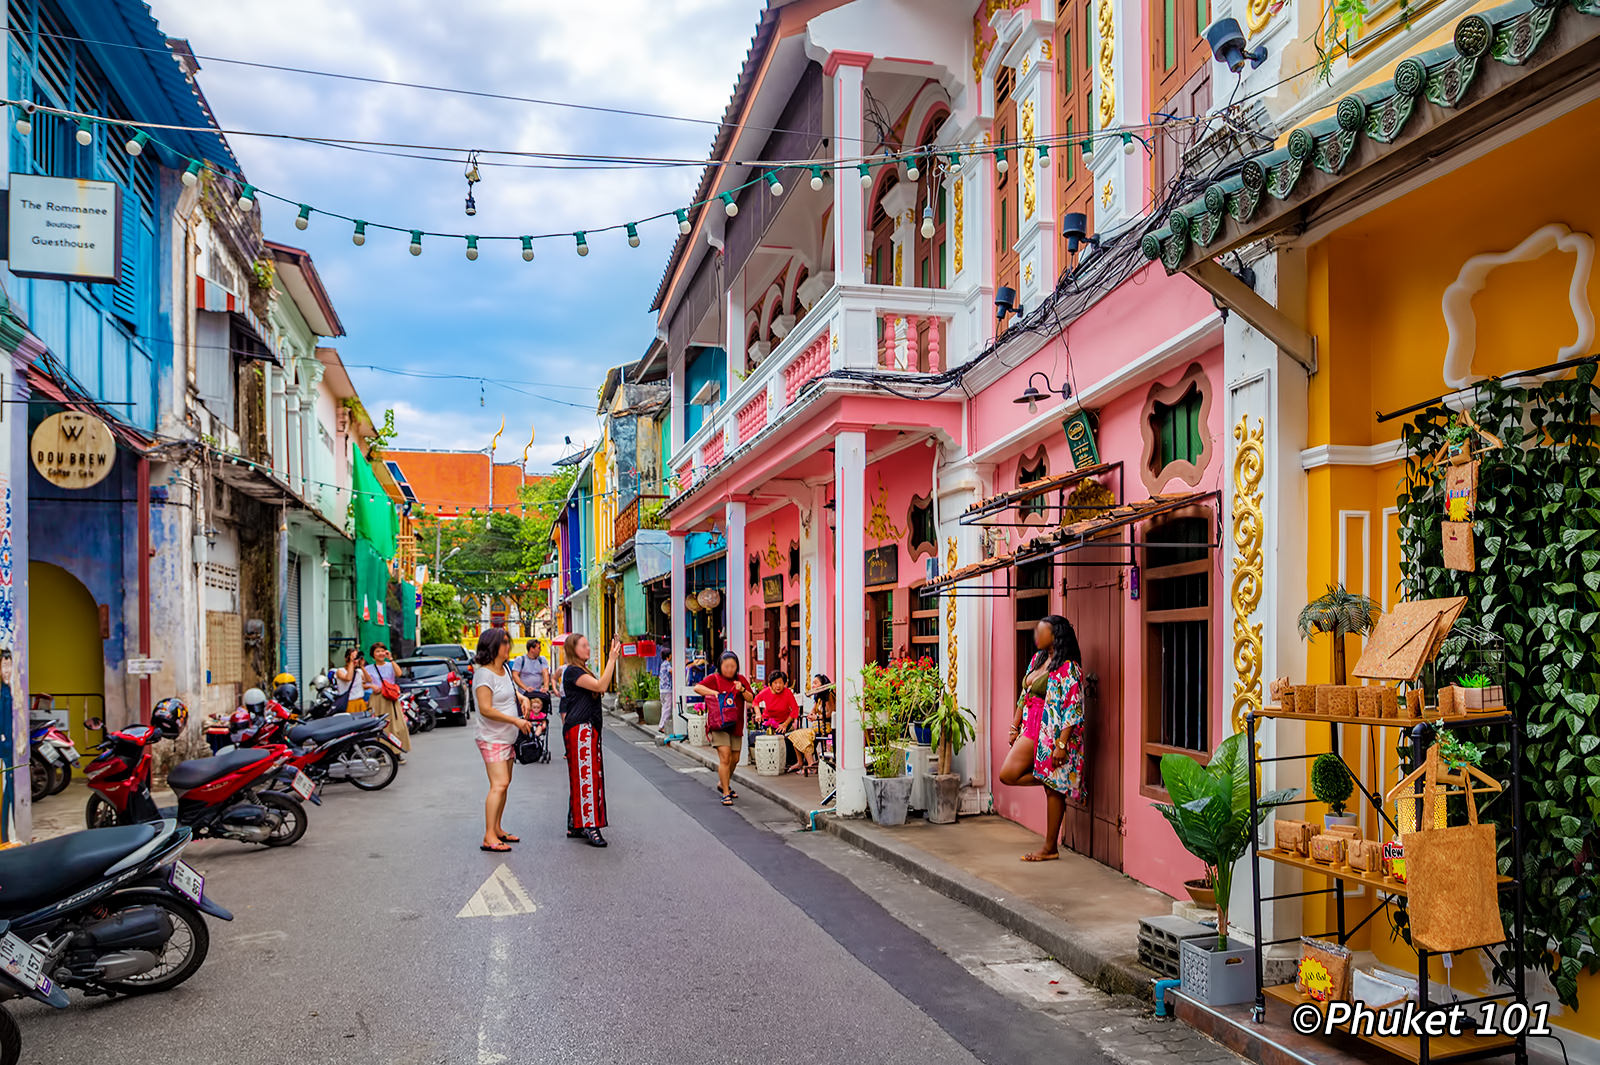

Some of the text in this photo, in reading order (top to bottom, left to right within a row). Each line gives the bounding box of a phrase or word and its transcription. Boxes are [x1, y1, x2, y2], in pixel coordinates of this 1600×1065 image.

[20, 199, 108, 216] The Rommanee
[45, 220, 81, 230] Boutique
[31, 235, 96, 250] Guesthouse
[61, 425, 84, 441] W
[1384, 843, 1404, 859] New
[24, 953, 41, 982] 1157
